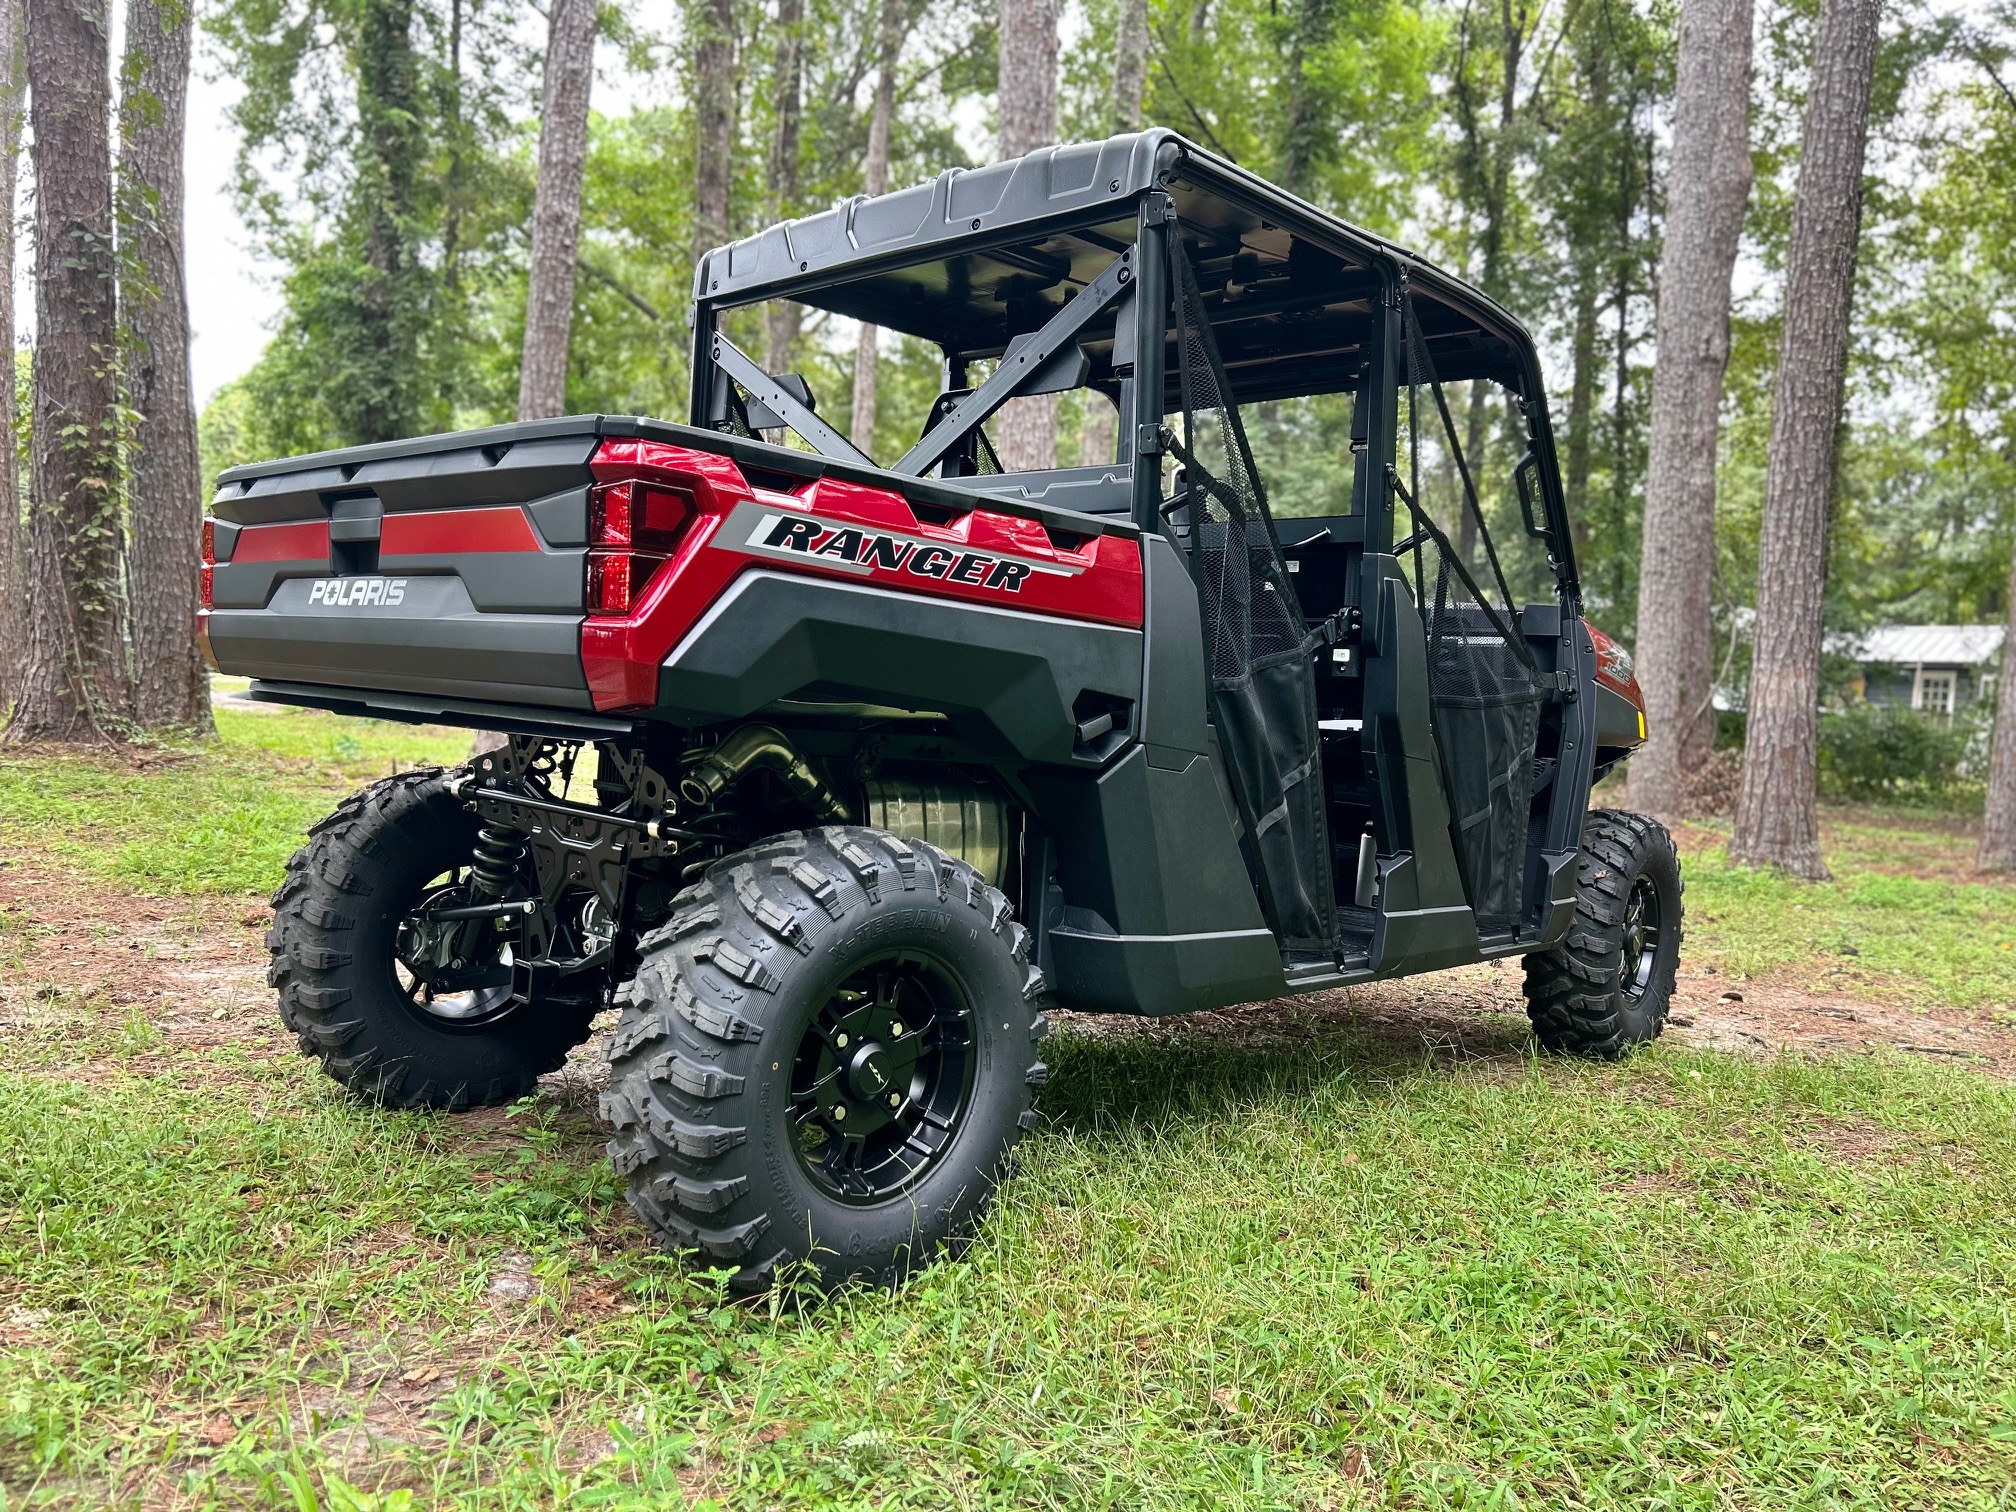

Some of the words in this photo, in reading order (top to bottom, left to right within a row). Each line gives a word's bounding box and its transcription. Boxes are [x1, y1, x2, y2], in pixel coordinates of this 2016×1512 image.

[763, 514, 1032, 593] RANGER
[308, 579, 408, 606] POLARIS
[1607, 663, 1631, 684] 1000
[828, 908, 952, 966] X-TERRAIN
